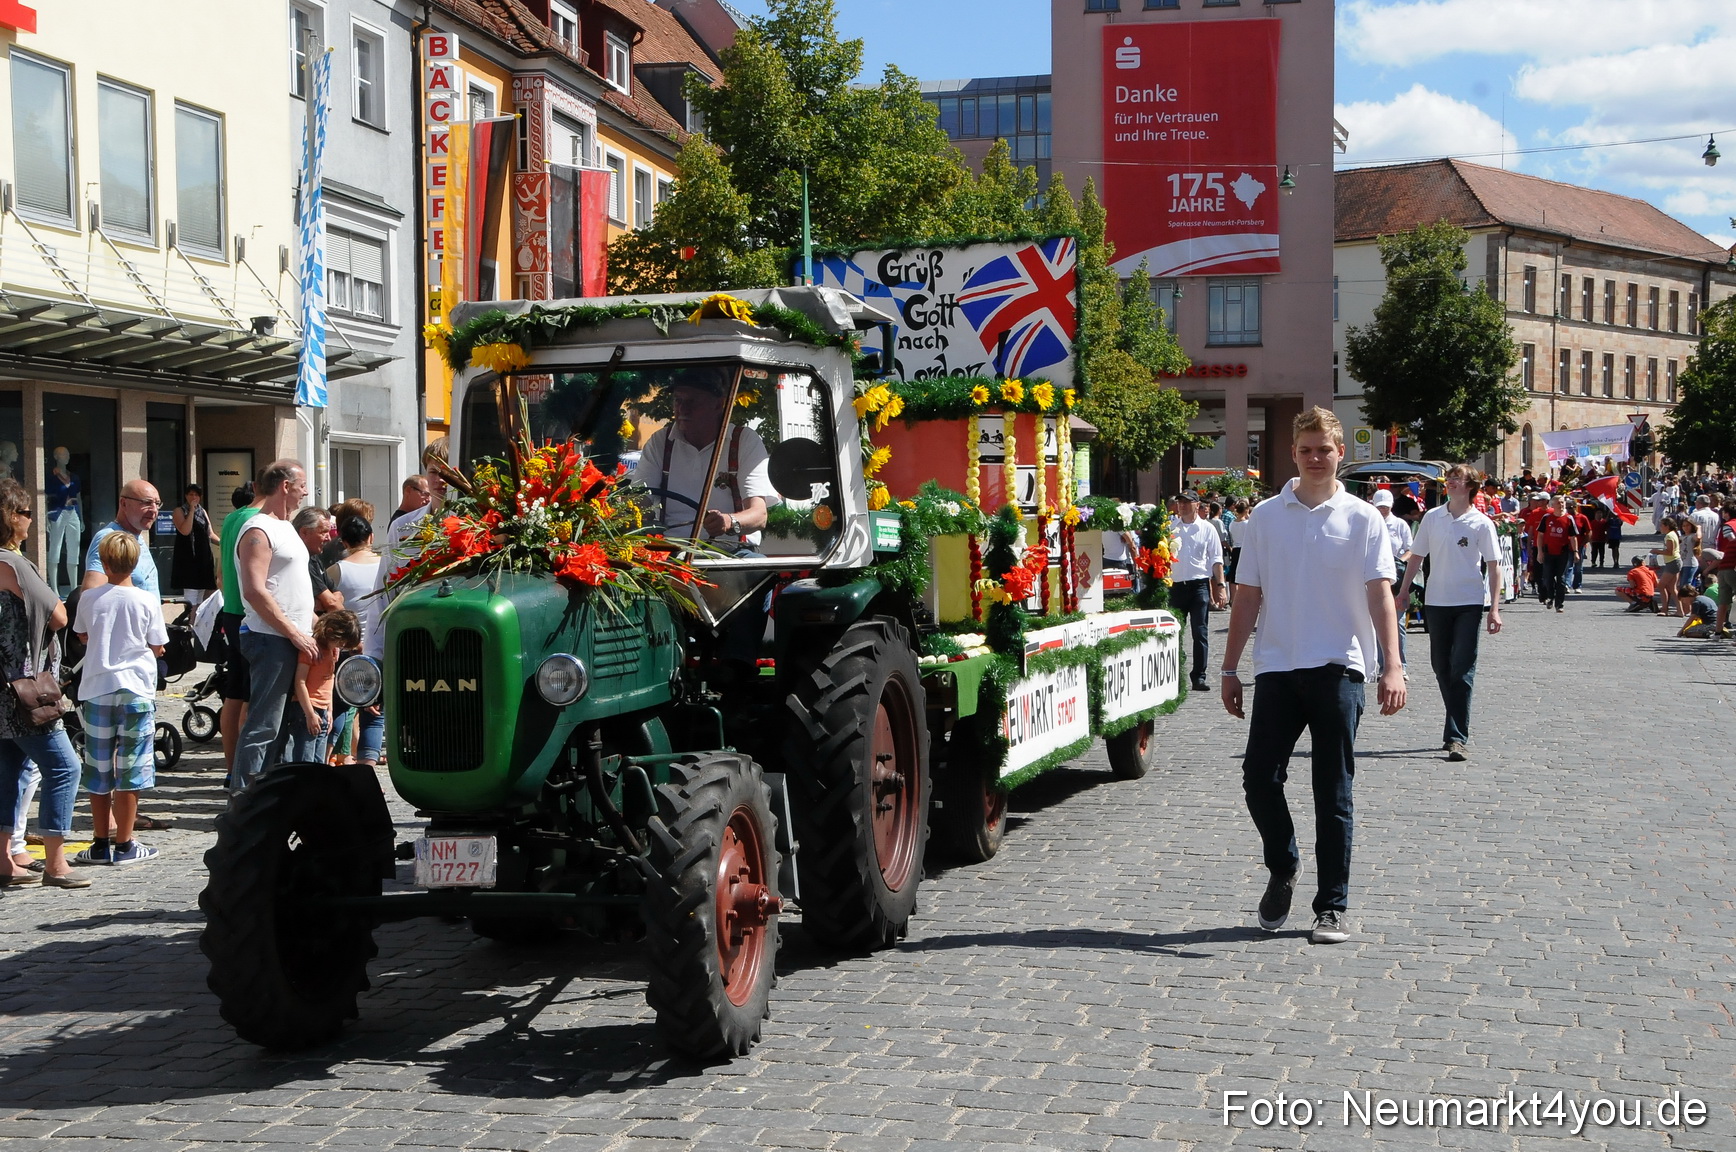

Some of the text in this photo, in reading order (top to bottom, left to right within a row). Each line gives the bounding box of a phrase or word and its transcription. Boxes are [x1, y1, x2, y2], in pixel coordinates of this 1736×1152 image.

[1115, 84, 1178, 103] Danke
[1114, 112, 1219, 125] für Ihr Vertrauen
[1115, 128, 1209, 142] und Ihre Treue.
[1167, 172, 1226, 197] 175
[1168, 197, 1226, 213] JAHRE
[1168, 218, 1265, 229] Sparkasse Neumarkt-Parsberg
[898, 327, 950, 352] nach
[1141, 647, 1177, 692] LONDON
[405, 678, 477, 692] MAN
[1056, 667, 1078, 694] STARKE
[1002, 684, 1054, 748] NEUMARKT
[1057, 695, 1076, 727] STADT
[431, 840, 457, 861] NM
[431, 862, 480, 883] 0727
